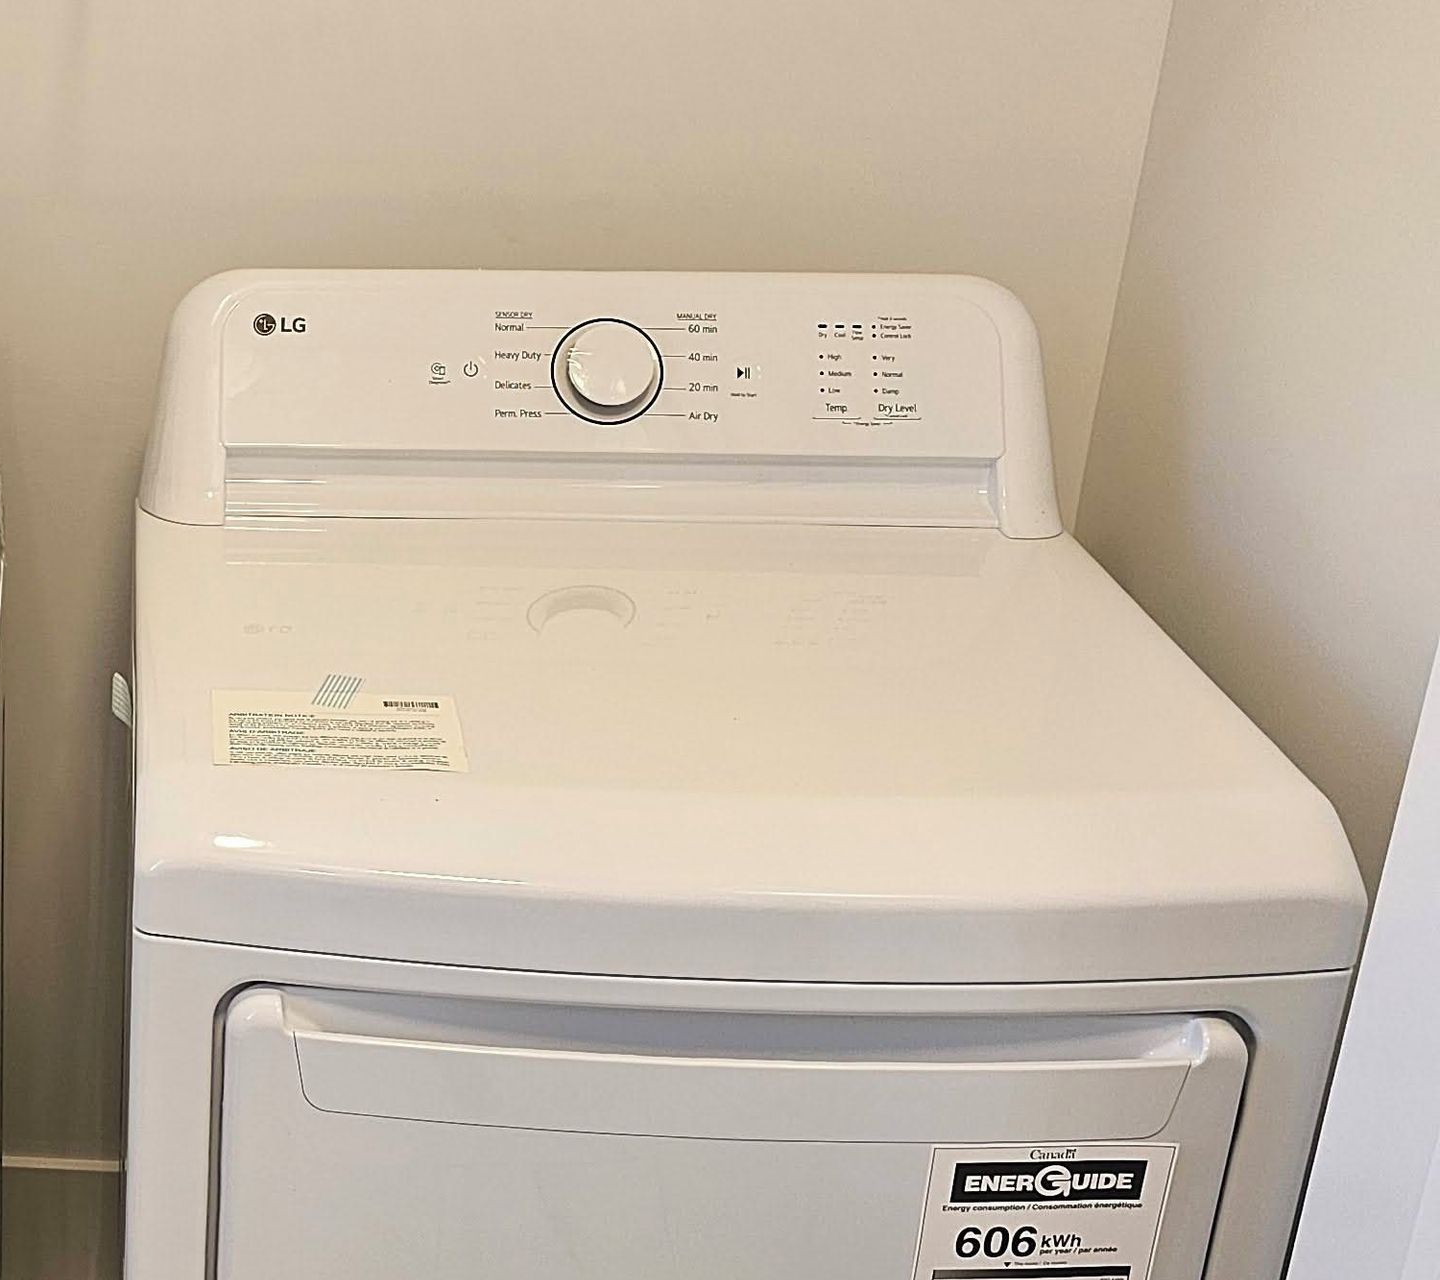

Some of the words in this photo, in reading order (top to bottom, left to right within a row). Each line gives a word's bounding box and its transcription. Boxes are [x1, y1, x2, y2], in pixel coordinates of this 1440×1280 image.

[280, 317, 306, 333] LG
[494, 323, 524, 332] Normal
[688, 324, 700, 333] 60
[702, 325, 718, 333] min
[494, 351, 519, 361] Heavy
[521, 351, 541, 362] Duty
[688, 353, 701, 361] 40
[702, 353, 718, 361] min
[494, 380, 532, 390] Delicates
[688, 382, 701, 392] 20
[702, 384, 718, 392] min
[494, 409, 517, 418] Perm.
[520, 409, 542, 418] Press
[878, 404, 893, 413] Dry
[895, 404, 917, 412] Level
[688, 411, 701, 420] Air
[703, 411, 718, 422] Dry
[1029, 1148, 1077, 1160] Canada
[964, 1164, 1135, 1197] ENERGUIDE
[942, 1204, 971, 1213] Energy
[972, 1204, 1026, 1212] consumption
[1032, 1202, 1093, 1211] Consommation
[1094, 1201, 1143, 1210] énergétique
[955, 1226, 1038, 1258] 606
[1041, 1234, 1082, 1248] kWh
[1039, 1248, 1053, 1256] per
[1054, 1248, 1072, 1256] year
[1078, 1247, 1092, 1255] par
